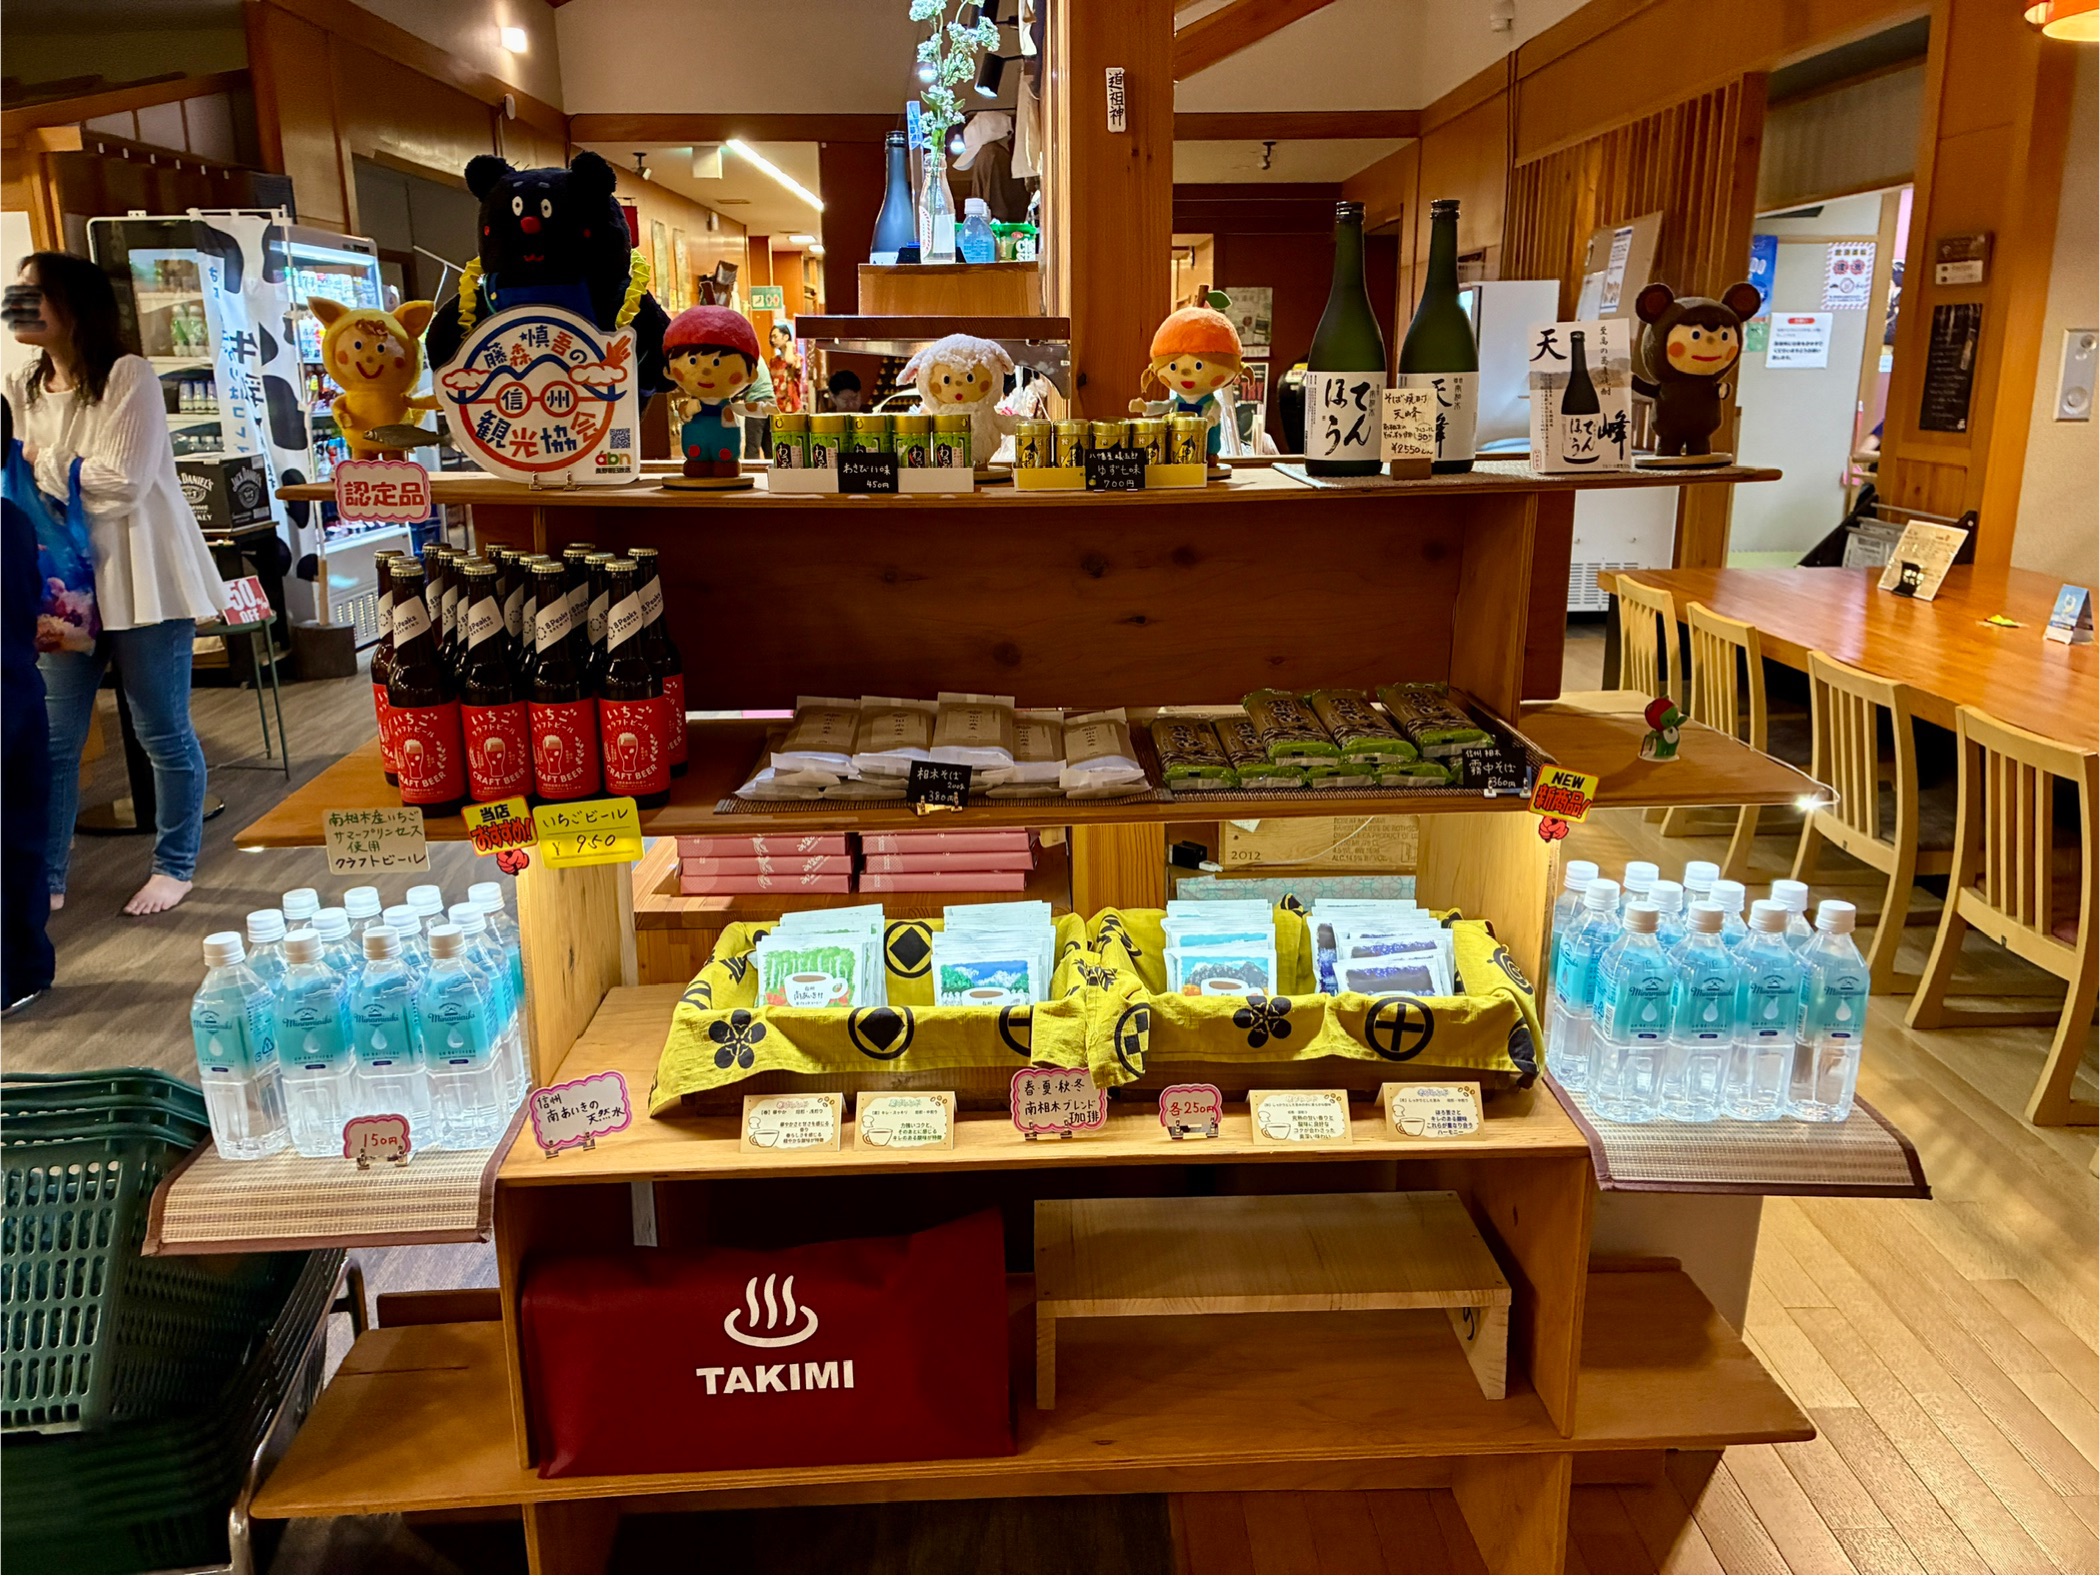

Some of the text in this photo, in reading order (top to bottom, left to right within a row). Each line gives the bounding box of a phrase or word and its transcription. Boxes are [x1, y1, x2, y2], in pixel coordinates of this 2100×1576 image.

[1108, 71, 1124, 127] 道祖神
[484, 324, 588, 369] 藤森慎吾の
[1529, 328, 1568, 362] 天
[501, 388, 571, 411] 信州
[475, 410, 599, 450] 観光協会
[1597, 409, 1631, 461] 峰
[1097, 463, 1141, 476] ゆず七味
[866, 480, 889, 488] 450円
[1103, 479, 1134, 488] 700円
[344, 481, 425, 506] 認定品
[239, 607, 260, 624] OFF
[545, 612, 568, 630] 8Peaks
[613, 610, 637, 629] 8Peaks
[393, 712, 438, 726] いちご
[471, 710, 518, 725] いちご
[532, 708, 577, 722] いちご
[607, 705, 652, 720] いちご
[422, 771, 447, 788] BEER
[473, 767, 526, 786] CRAFT BEER
[559, 767, 584, 783] BEER
[606, 763, 658, 780] CRAFT BEER
[917, 767, 962, 780] 相木そば
[1551, 770, 1586, 790] NEW
[329, 810, 419, 827] 南相木産いちご
[480, 804, 510, 823] 当店
[543, 808, 628, 828] いちごビール
[334, 825, 423, 844] サマープリンセス
[471, 816, 532, 852] おすすめ!
[347, 841, 380, 853] 使用
[576, 834, 616, 853] 950
[336, 854, 426, 869] クラフトビール
[1231, 850, 1261, 861] 2012
[427, 1010, 475, 1023] Minamiaiki
[537, 1094, 562, 1109] 信州
[1025, 1099, 1095, 1116] 南相木ブレンド
[1169, 1101, 1215, 1117] 各250円
[547, 1100, 599, 1123] 南あいきの
[586, 1106, 625, 1125] 天然水
[1069, 1111, 1100, 1123] 珈琲
[362, 1133, 398, 1147] 150円
[696, 1360, 854, 1395] TAKIMI
